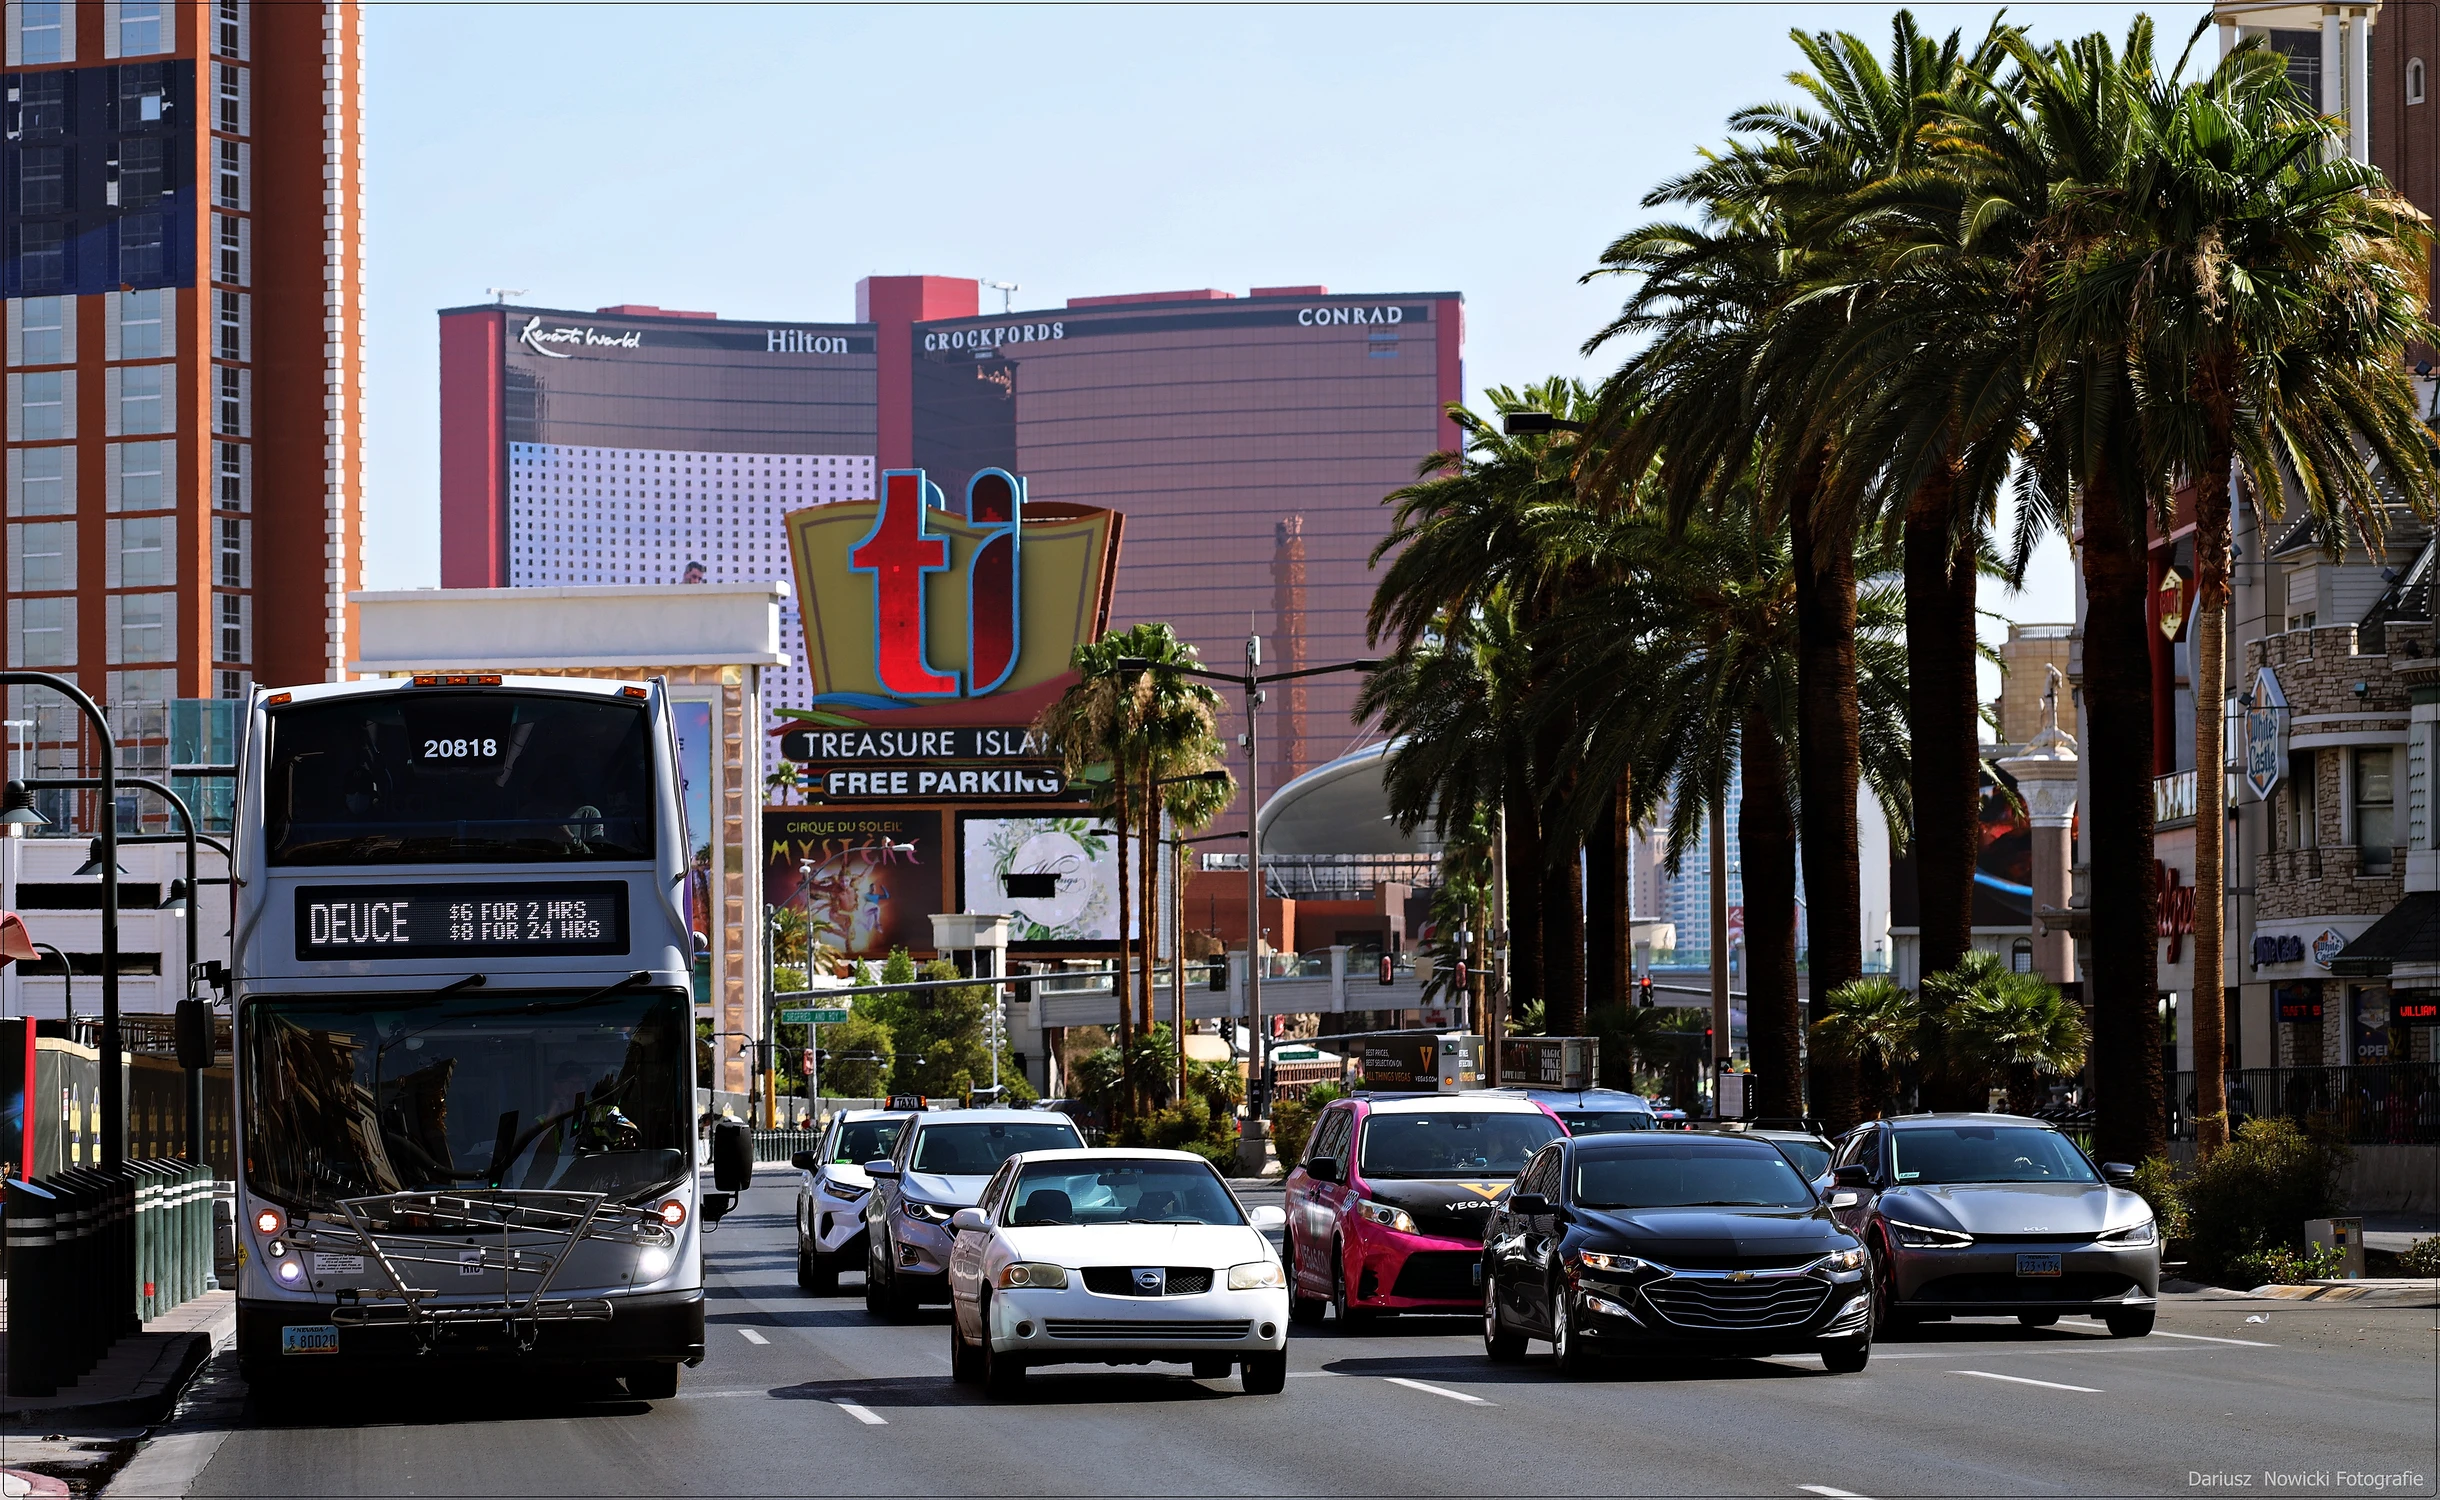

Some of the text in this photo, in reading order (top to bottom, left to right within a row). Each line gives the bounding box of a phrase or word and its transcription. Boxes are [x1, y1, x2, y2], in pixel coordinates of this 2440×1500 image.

[1298, 306, 1403, 326] CONRAD
[767, 330, 848, 354] Hilton
[925, 322, 1064, 351] CROCKFORDS
[2250, 712, 2276, 747] White
[424, 738, 498, 758] 20818
[802, 731, 955, 757] TREASURE
[2249, 745, 2276, 776] Castle
[829, 771, 1059, 795] FREE PARKING
[787, 821, 903, 835] CIRQUE DU SOLEIL
[449, 901, 587, 921] $6 FOR 2 HRS
[310, 902, 410, 944] DEUCE
[449, 920, 600, 941] $8 FOR 24 HRS
[2318, 941, 2340, 956] White
[815, 1012, 825, 1021] AND
[2400, 1006, 2437, 1017] WILLIAM
[1541, 1048, 1561, 1058] MAGIC
[1366, 1059, 1374, 1067] BEST
[1375, 1059, 1395, 1067] SELECTION
[1541, 1058, 1561, 1069] MIKE
[1366, 1072, 1411, 1081] ALL THINGS VEGAS
[1541, 1069, 1561, 1081] LIVE
[897, 1098, 915, 1108] TAXI
[300, 1335, 336, 1348] 80020
